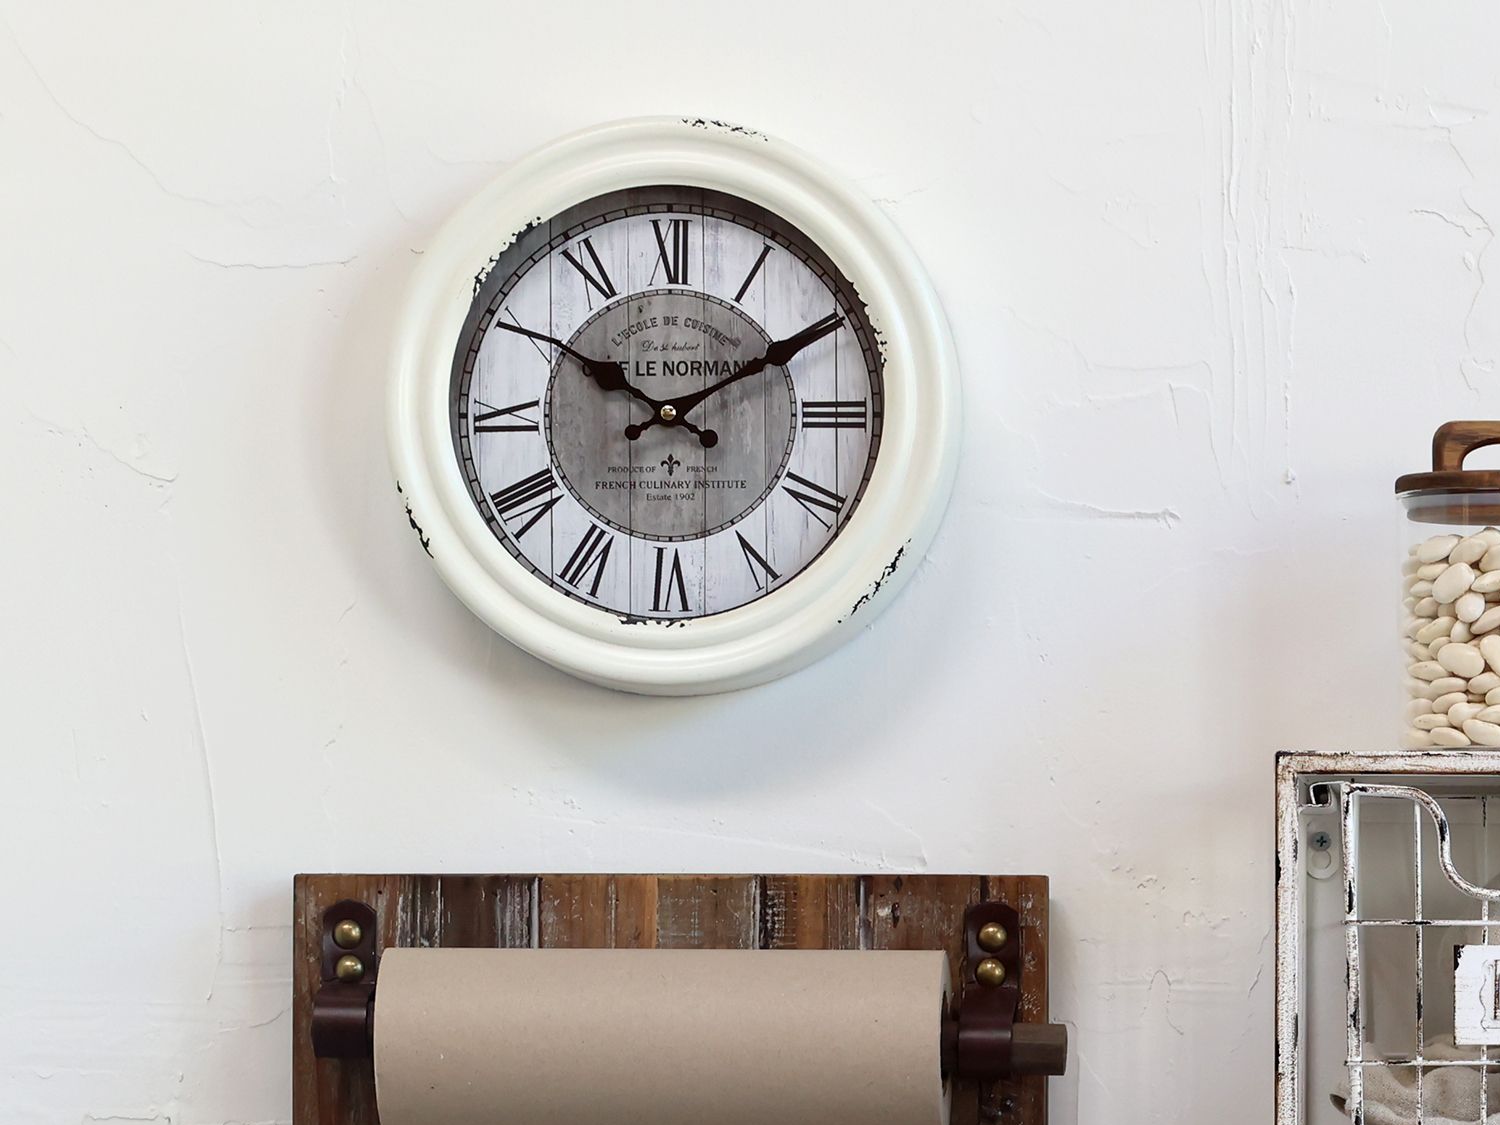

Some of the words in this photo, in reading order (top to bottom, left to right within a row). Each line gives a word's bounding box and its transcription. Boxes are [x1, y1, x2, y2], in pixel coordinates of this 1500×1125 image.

[647, 218, 693, 286] XII
[731, 241, 776, 306] I
[663, 315, 679, 326] DE
[635, 360, 657, 377] LE
[801, 396, 868, 433] III
[607, 465, 645, 474] PRODUCE
[645, 465, 657, 474] OF
[686, 465, 718, 474] FRENCH
[595, 480, 637, 490] FRENCH
[638, 480, 691, 490] CULINARY
[693, 479, 747, 490] INSTITUTE
[646, 492, 672, 502] Estate
[674, 492, 696, 502] 1902
